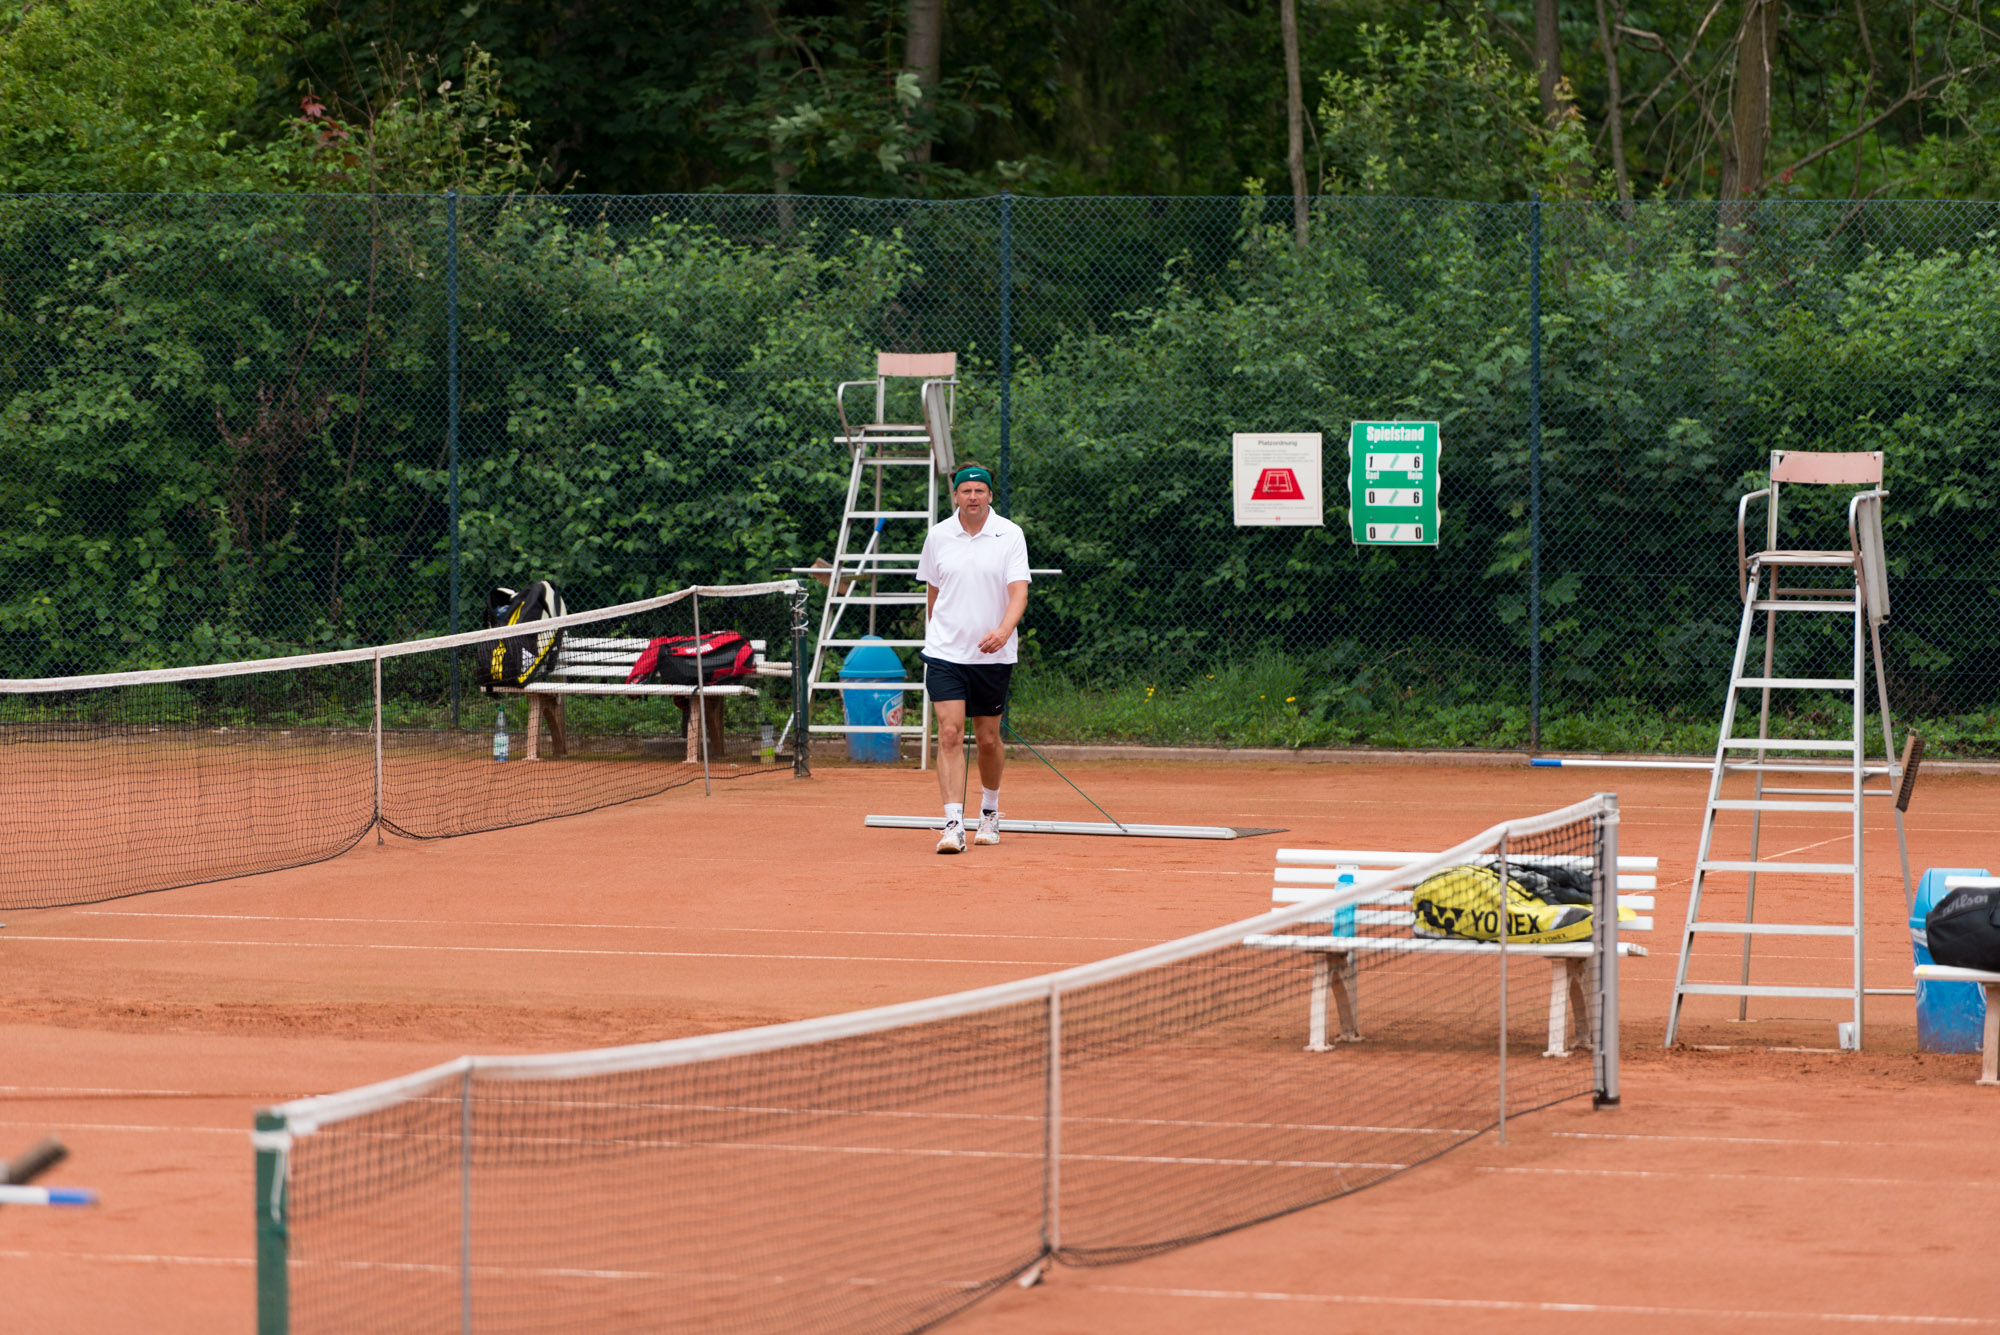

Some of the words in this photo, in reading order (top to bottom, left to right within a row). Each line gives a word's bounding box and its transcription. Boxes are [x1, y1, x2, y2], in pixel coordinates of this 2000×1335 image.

[1366, 426, 1424, 443] Spielstand
[1369, 455, 1374, 468] 1
[1413, 456, 1421, 469] 6
[1368, 491, 1375, 504] 0
[1413, 491, 1420, 504] 6
[1369, 526, 1376, 539] 0
[1415, 526, 1422, 540] 0
[1471, 909, 1541, 935] YONEX
